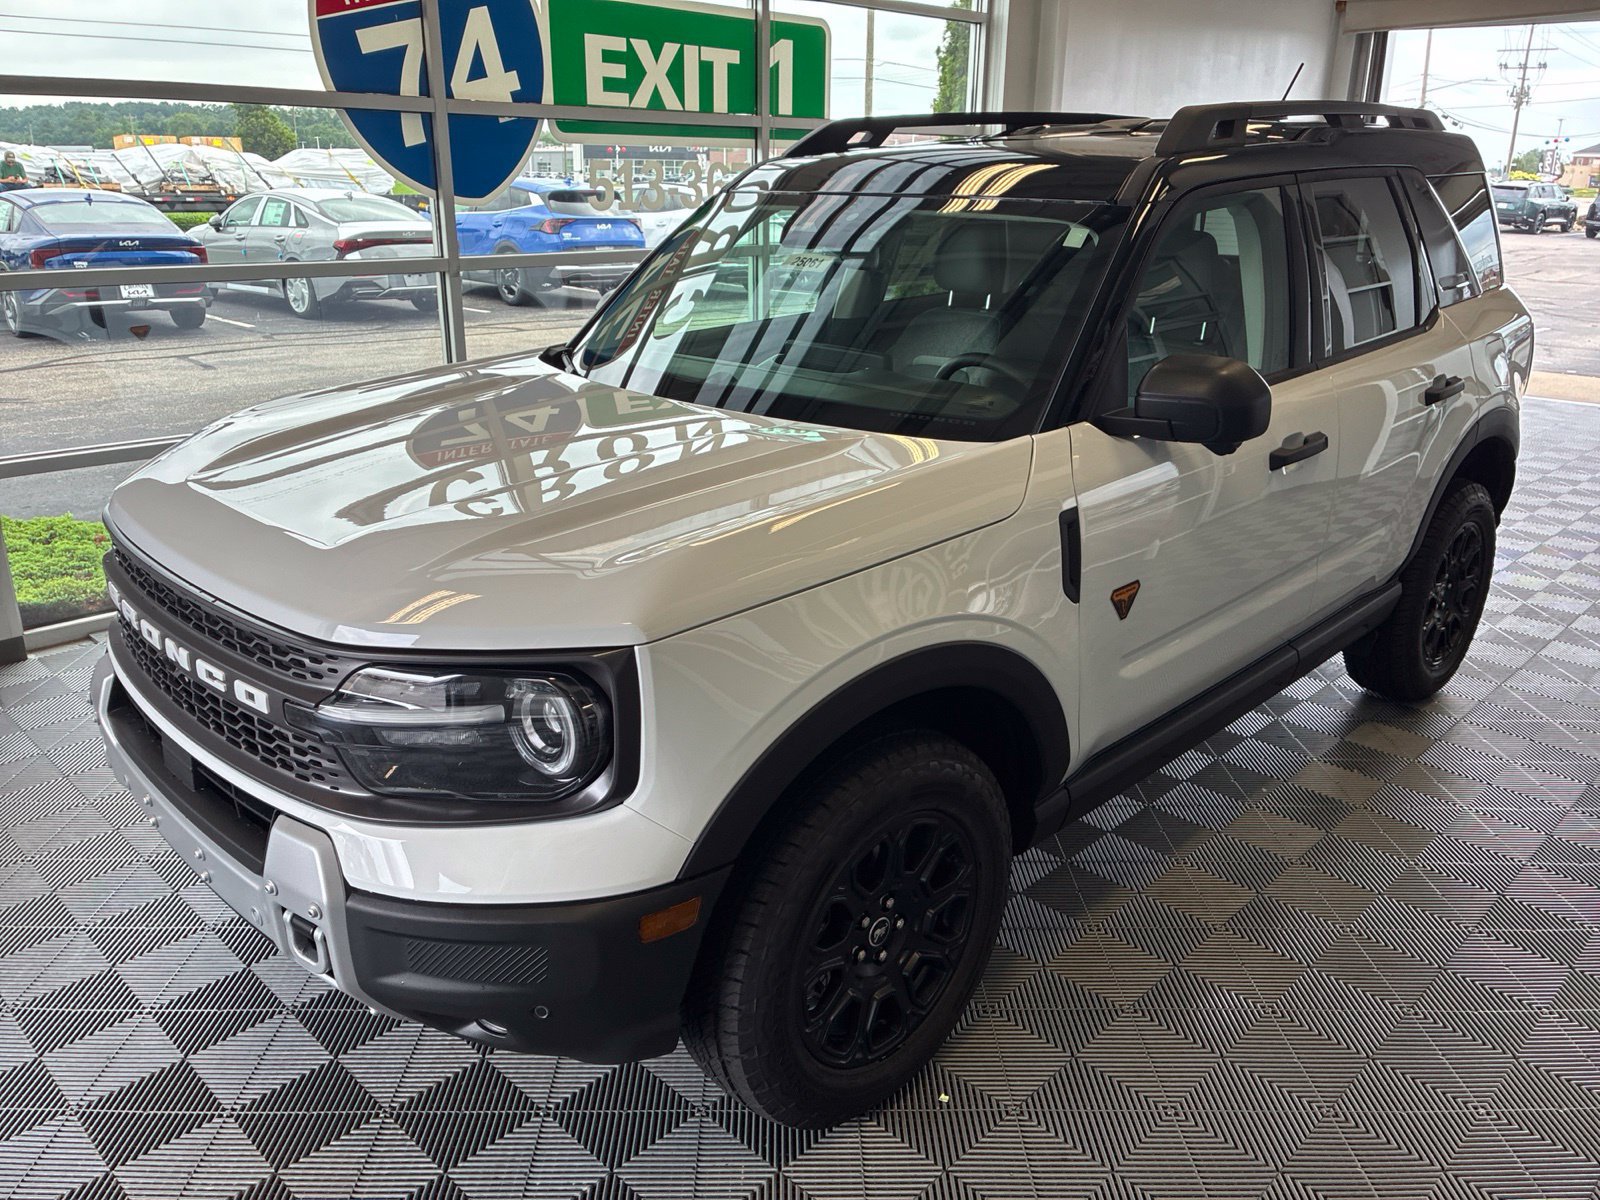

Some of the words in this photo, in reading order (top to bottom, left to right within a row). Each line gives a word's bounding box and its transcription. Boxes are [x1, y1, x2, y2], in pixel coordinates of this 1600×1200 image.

[355, 6, 521, 147] 74
[584, 33, 740, 113] EXIT
[769, 38, 793, 116] 1
[588, 160, 751, 210] 513-36
[790, 256, 825, 269] 25061
[108, 581, 271, 715] BRONCO
